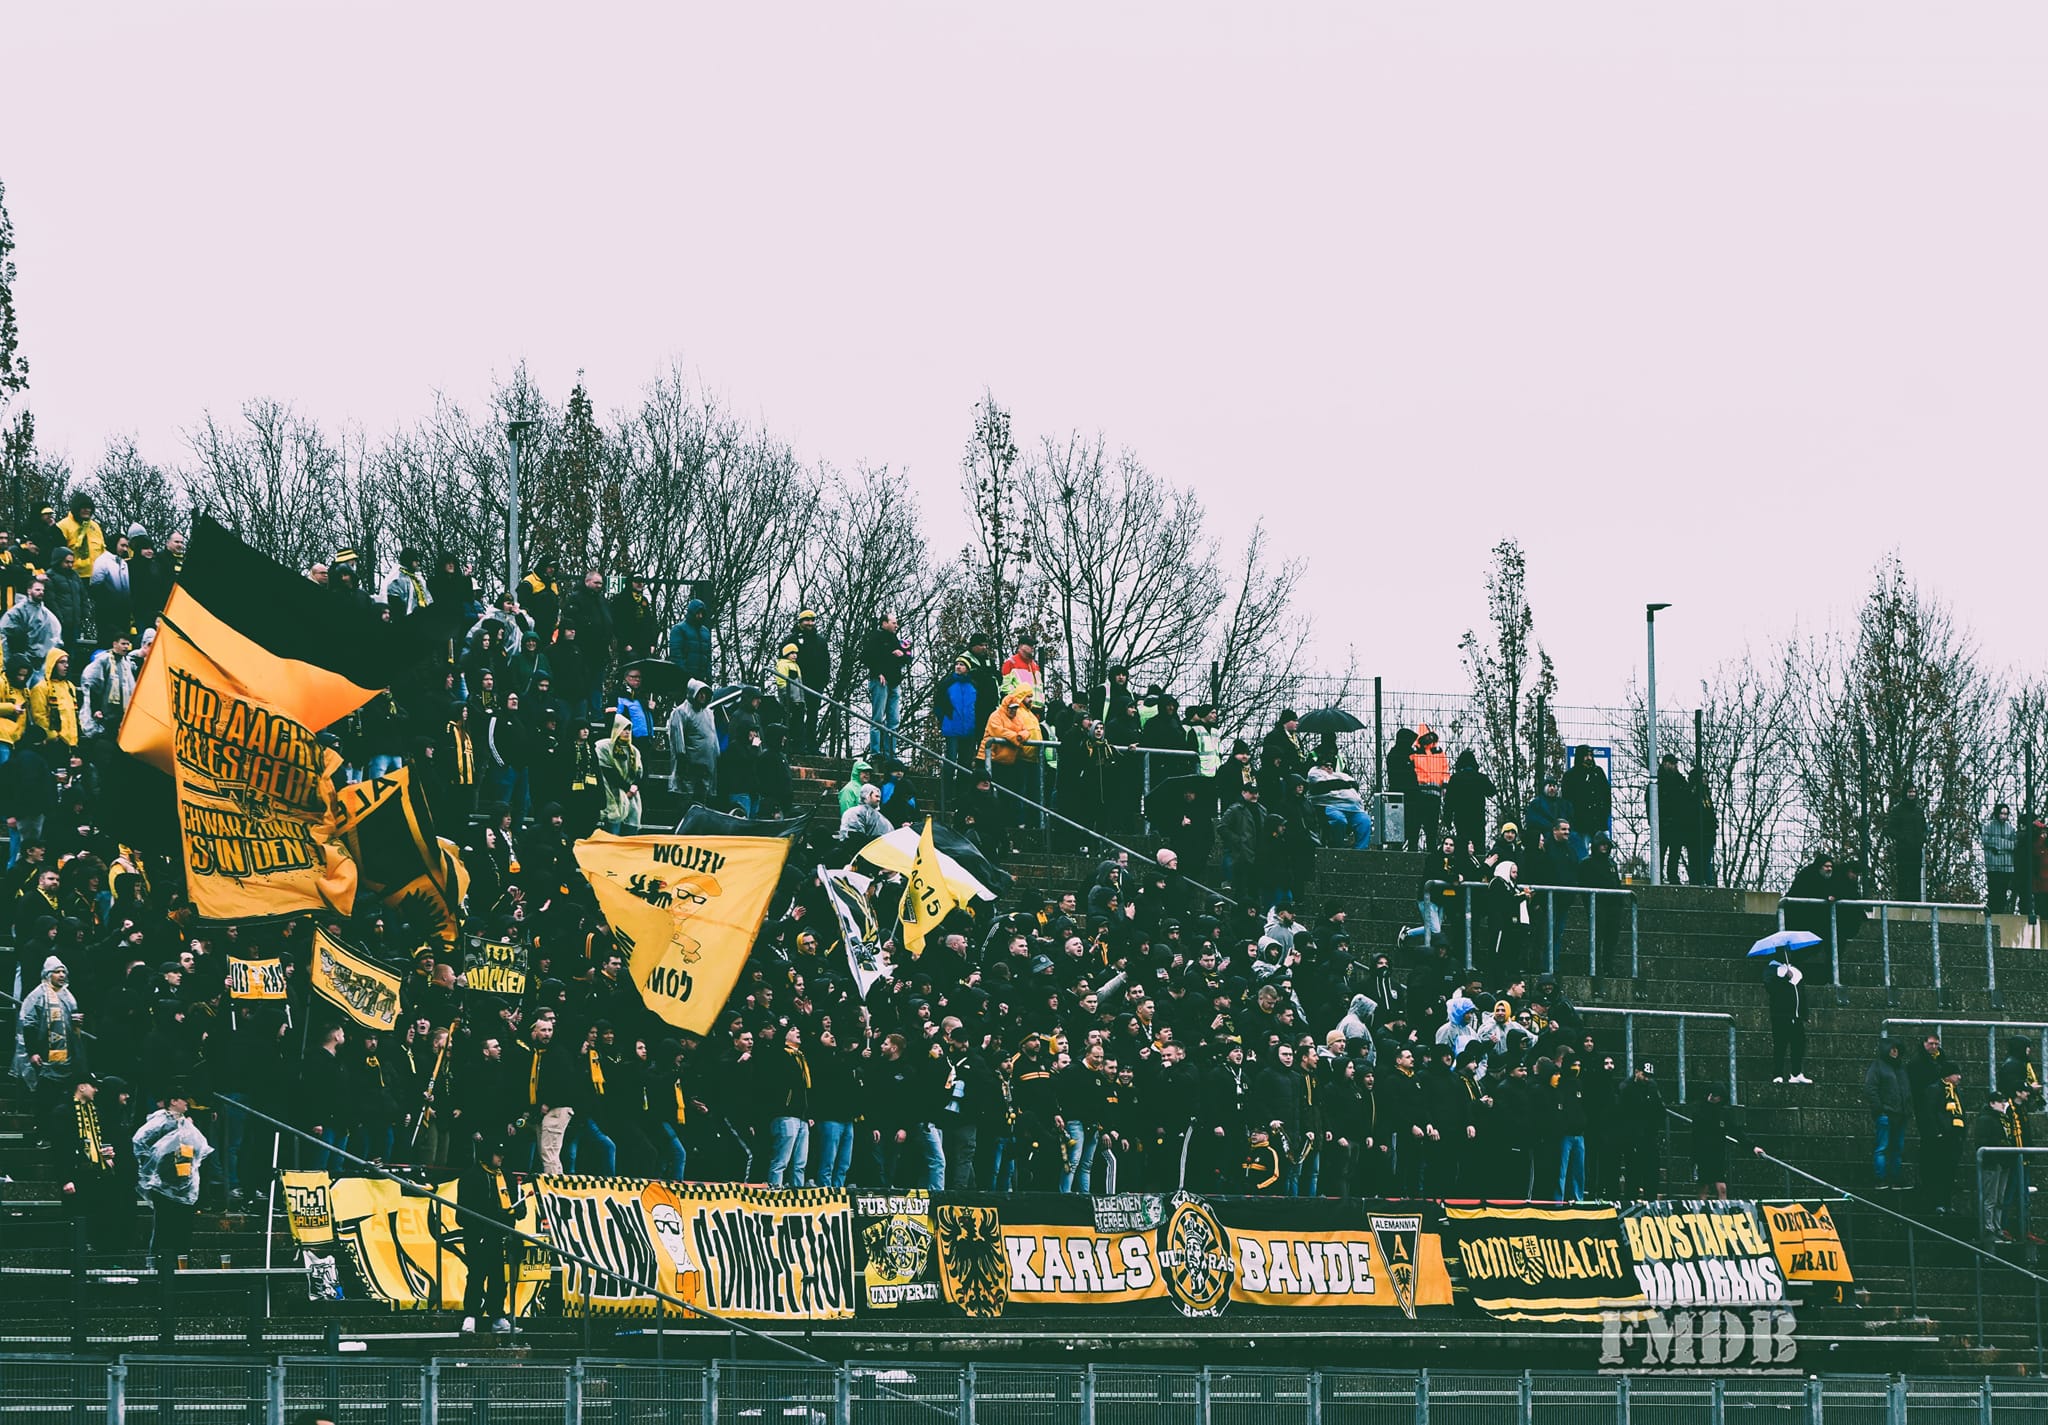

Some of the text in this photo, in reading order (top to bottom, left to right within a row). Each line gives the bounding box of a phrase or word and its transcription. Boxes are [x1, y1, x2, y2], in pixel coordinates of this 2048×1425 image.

[175, 725, 241, 780] ALLES
[184, 803, 257, 839] CHWARZ
[215, 838, 245, 873] IN
[251, 838, 306, 870] DEN
[466, 965, 526, 993] AACHEN
[300, 1206, 327, 1217] REGEL
[857, 1192, 930, 1215] FÜR STADT
[1092, 1195, 1142, 1212] LEGENDEN
[1375, 1220, 1417, 1230] ALEMANNIA
[1623, 1212, 1771, 1261] BOXSTAFFEL
[548, 1193, 657, 1298] YELLOW
[693, 1208, 854, 1313] CONNECTION
[1006, 1235, 1375, 1294] KARLS BANDE
[1393, 1234, 1409, 1260] A
[1540, 1237, 1623, 1281] WACHT
[1633, 1257, 1783, 1310] HOOLIGANS
